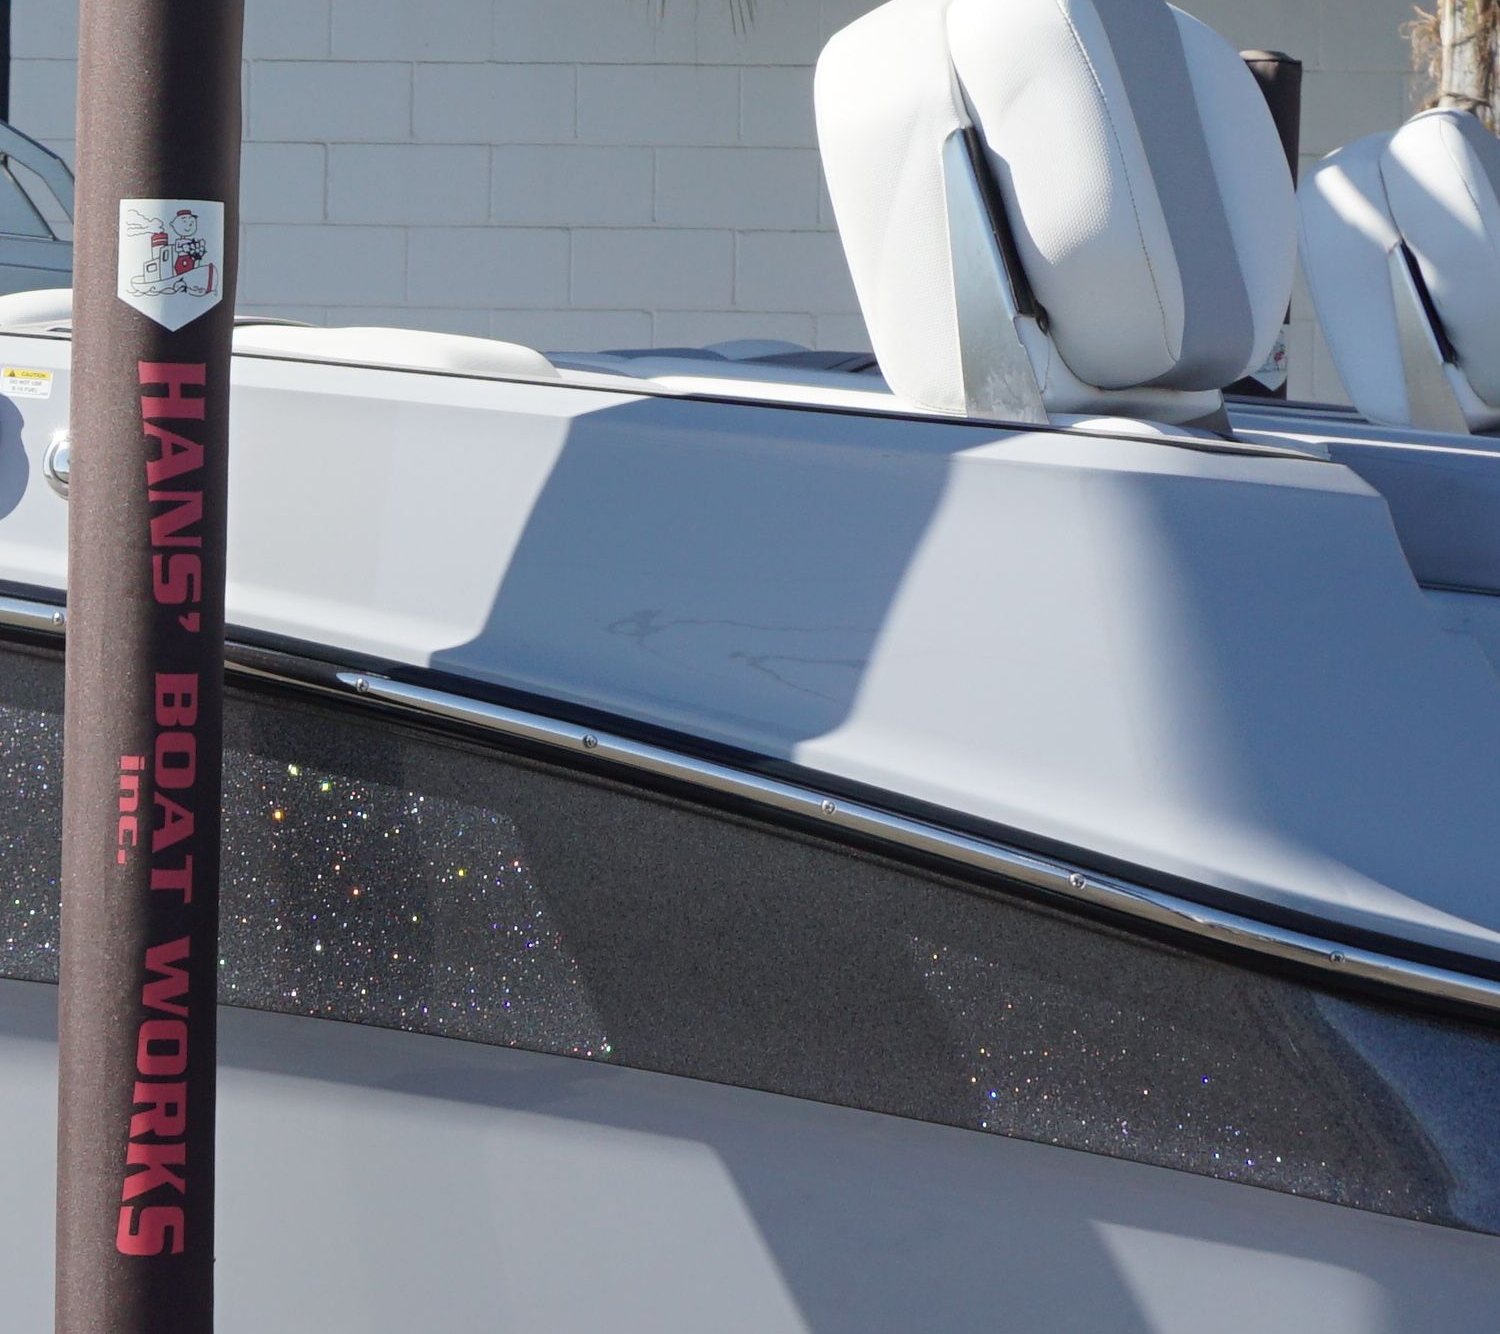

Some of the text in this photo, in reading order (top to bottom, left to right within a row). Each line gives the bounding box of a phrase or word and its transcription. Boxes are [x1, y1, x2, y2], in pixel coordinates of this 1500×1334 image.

[117, 754, 146, 865] inc.
[149, 673, 200, 904] BOAT
[115, 935, 191, 1256] WORKS
